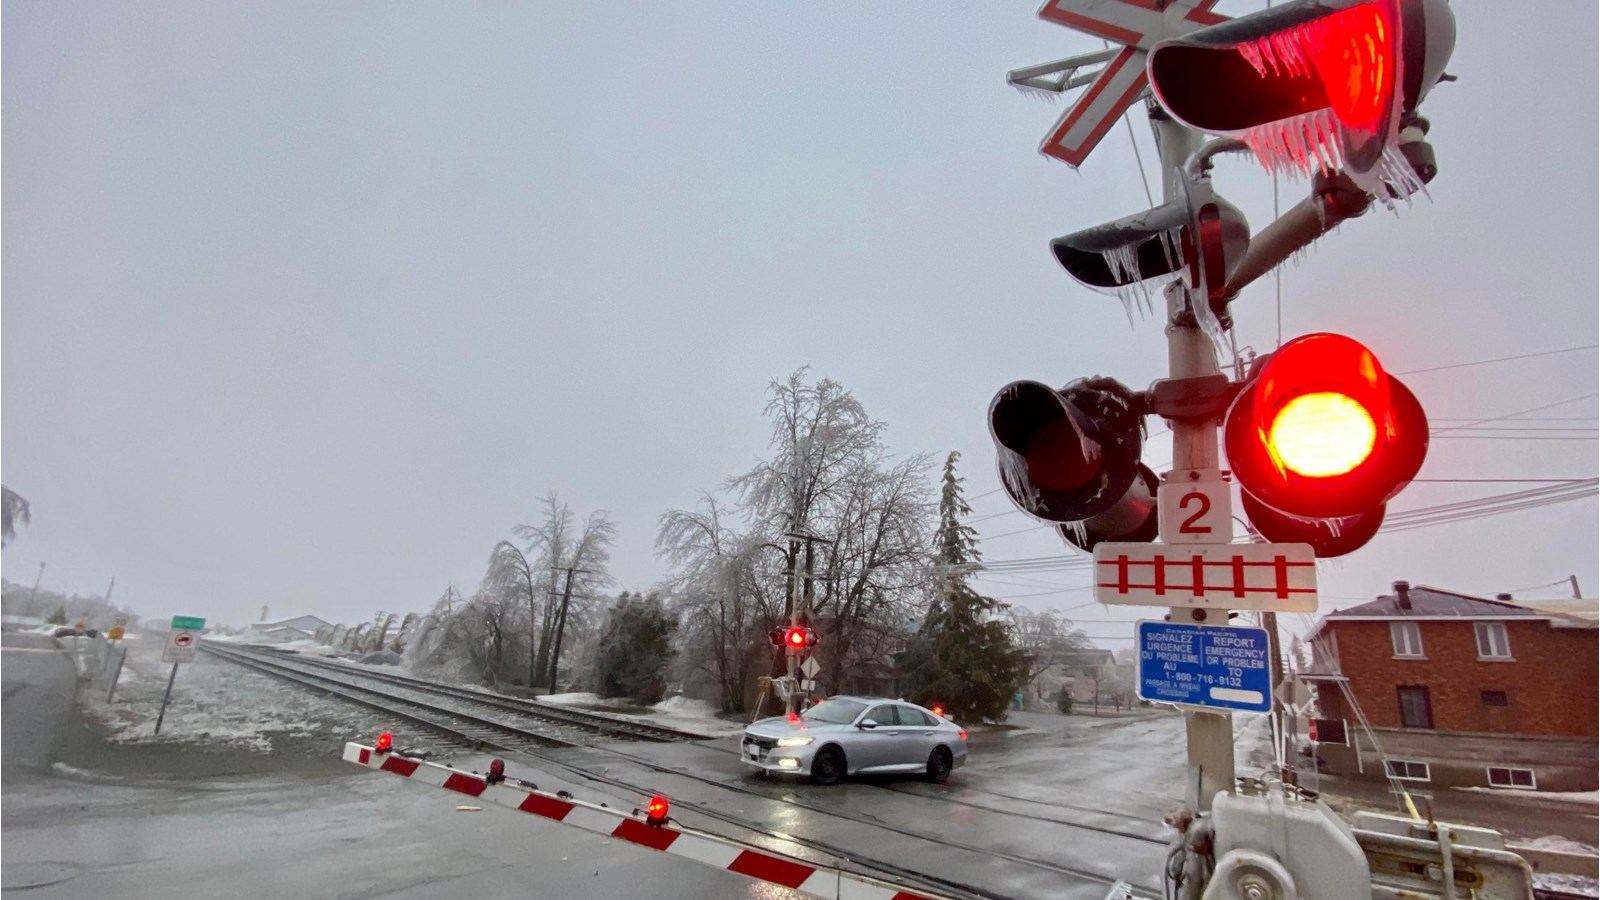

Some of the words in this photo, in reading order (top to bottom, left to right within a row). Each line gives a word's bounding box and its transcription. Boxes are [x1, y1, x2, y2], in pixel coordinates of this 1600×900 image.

[1179, 492, 1212, 534] 2
[1146, 632, 1192, 643] SIGNALEZ
[1213, 637, 1255, 648] REPORT
[1147, 642, 1192, 653] URGENCE
[1205, 646, 1264, 658] EMERGENCY
[1142, 650, 1153, 660] OU
[1163, 662, 1177, 671] AU
[1207, 656, 1219, 665] OR
[1222, 657, 1265, 669] PROBLEM
[1228, 667, 1242, 677] TO
